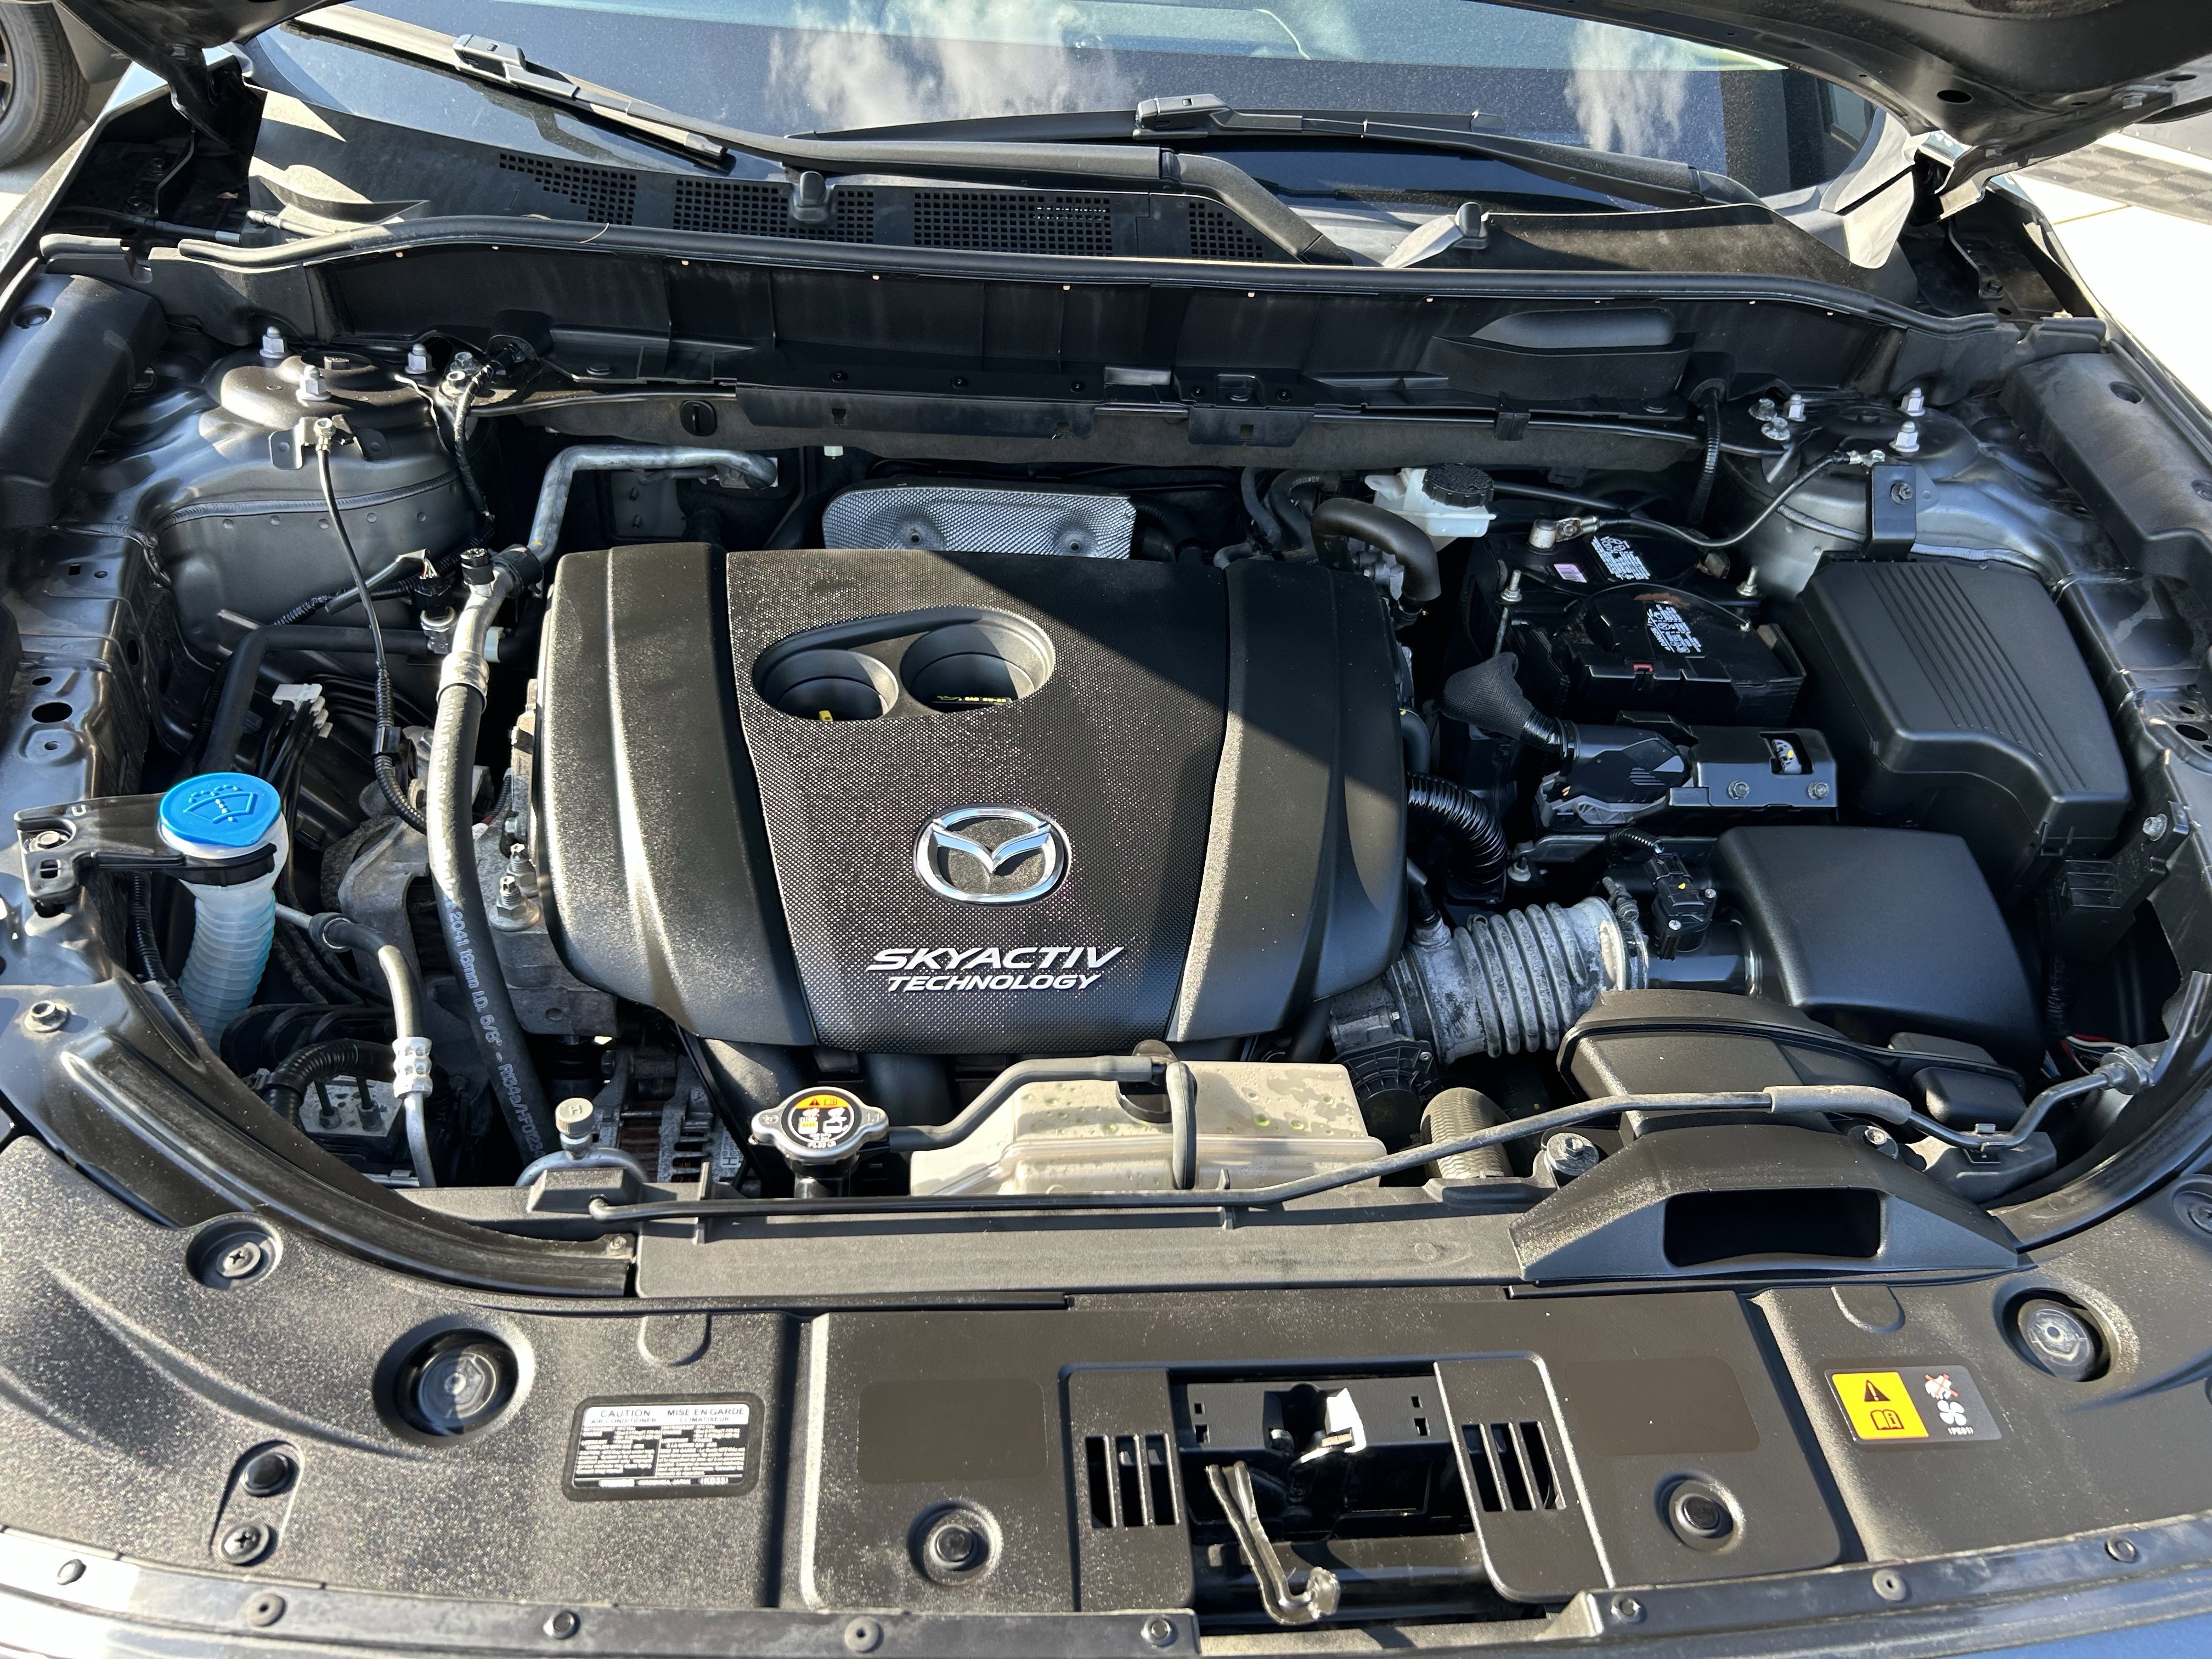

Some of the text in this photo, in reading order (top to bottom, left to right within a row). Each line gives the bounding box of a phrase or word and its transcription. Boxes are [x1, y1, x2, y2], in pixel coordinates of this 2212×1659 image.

[449, 911, 470, 947] 2041
[866, 947, 1124, 970] SKYACTIV
[888, 973, 1102, 992] TECHNOLOGY
[568, 1104, 582, 1115] H
[722, 1157, 737, 1165] H
[601, 1409, 651, 1418] CAUTION
